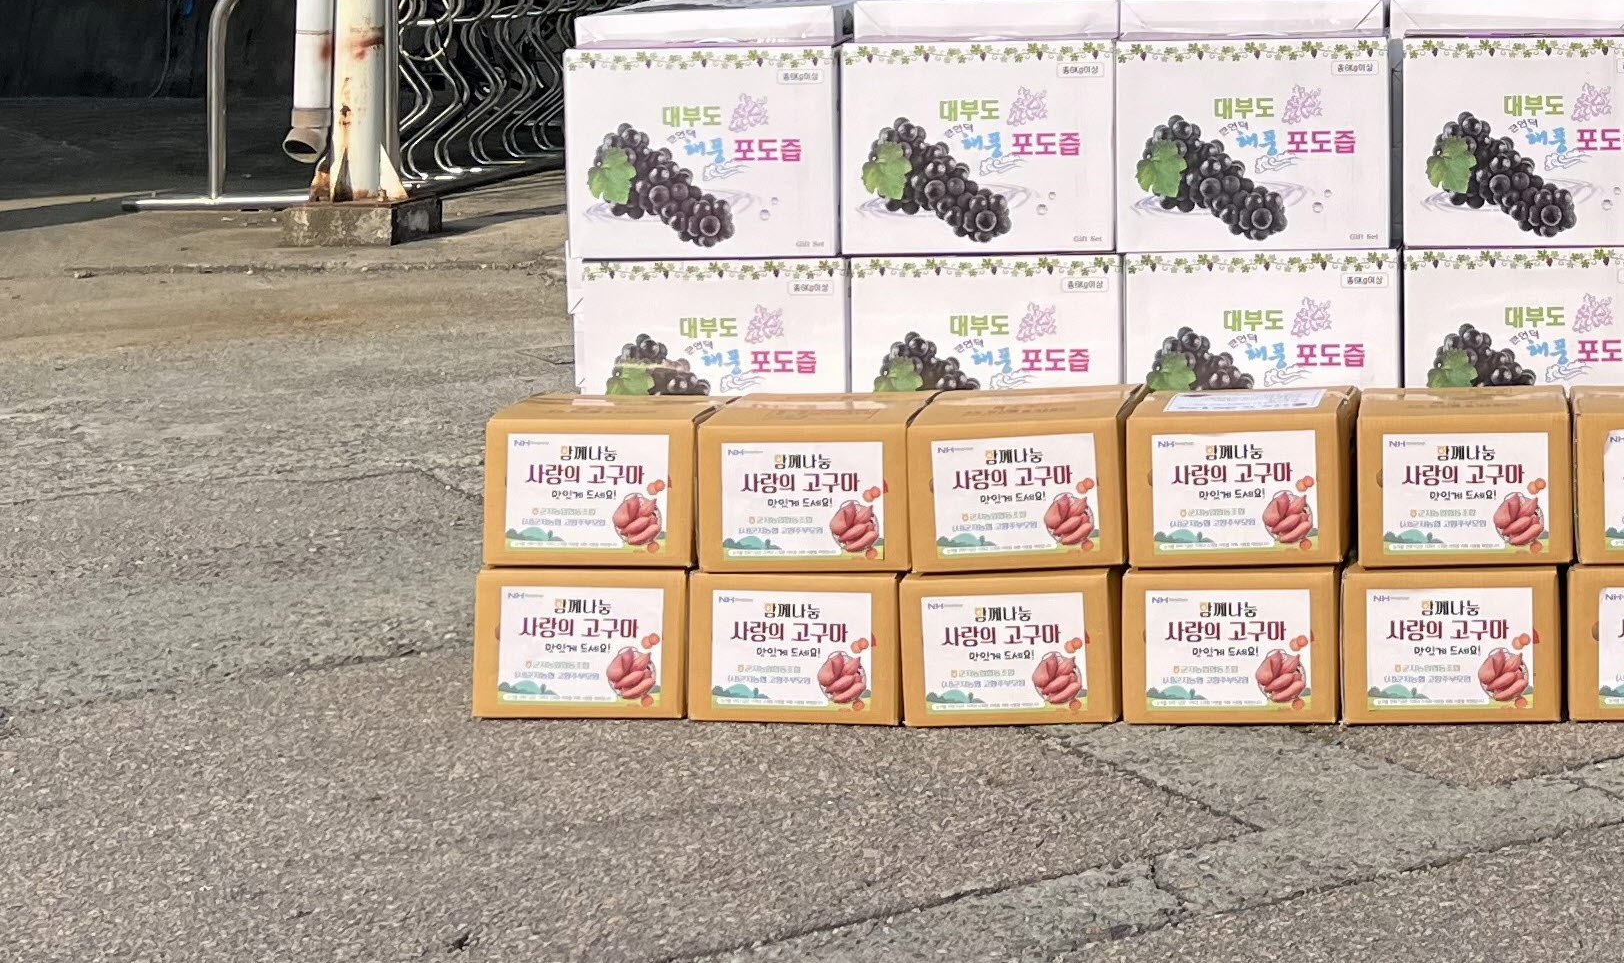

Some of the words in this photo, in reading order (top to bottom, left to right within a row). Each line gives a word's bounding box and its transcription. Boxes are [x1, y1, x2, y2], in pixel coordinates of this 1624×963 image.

[939, 100, 999, 121] 대부도
[1214, 98, 1274, 118] 대부도
[1504, 95, 1564, 115] 대부도
[662, 106, 721, 126] 대부도
[734, 139, 800, 162] 포도즙
[1012, 132, 1079, 156] 포도즙
[1287, 130, 1355, 154] 포도즙
[680, 317, 737, 337] 대부도
[950, 315, 1009, 336] 대부도
[1223, 310, 1283, 331] 대부도
[1505, 306, 1565, 327] 대부도
[751, 351, 816, 373] 포도즙
[1022, 349, 1089, 372] 포도즙
[1297, 344, 1364, 367] 포도즙
[560, 445, 618, 462] 함께나눔
[985, 447, 1043, 465] 함께나눔
[1437, 445, 1496, 461] 함께나눔
[525, 464, 580, 485] 사랑의
[588, 464, 645, 486] 고구마
[740, 473, 795, 494] 사랑의
[803, 473, 860, 493] 고구마
[951, 468, 1007, 491] 사랑의
[1015, 465, 1073, 488] 고구마
[1171, 464, 1227, 486] 사랑의
[1235, 462, 1293, 484] 고구마
[1401, 465, 1458, 486] 사랑의
[1466, 464, 1525, 485] 고구마
[764, 602, 821, 620] 함께나눔
[518, 616, 574, 639] 사랑의
[581, 618, 640, 639] 고구마
[730, 620, 784, 643] 사랑의
[792, 622, 849, 644] 고구마
[941, 626, 996, 648] 사랑의
[1004, 624, 1061, 645] 고구마
[1164, 621, 1220, 642] 사랑의
[1229, 621, 1287, 642] 고구마
[1386, 620, 1443, 641] 사랑의
[1451, 619, 1510, 640] 고구마
